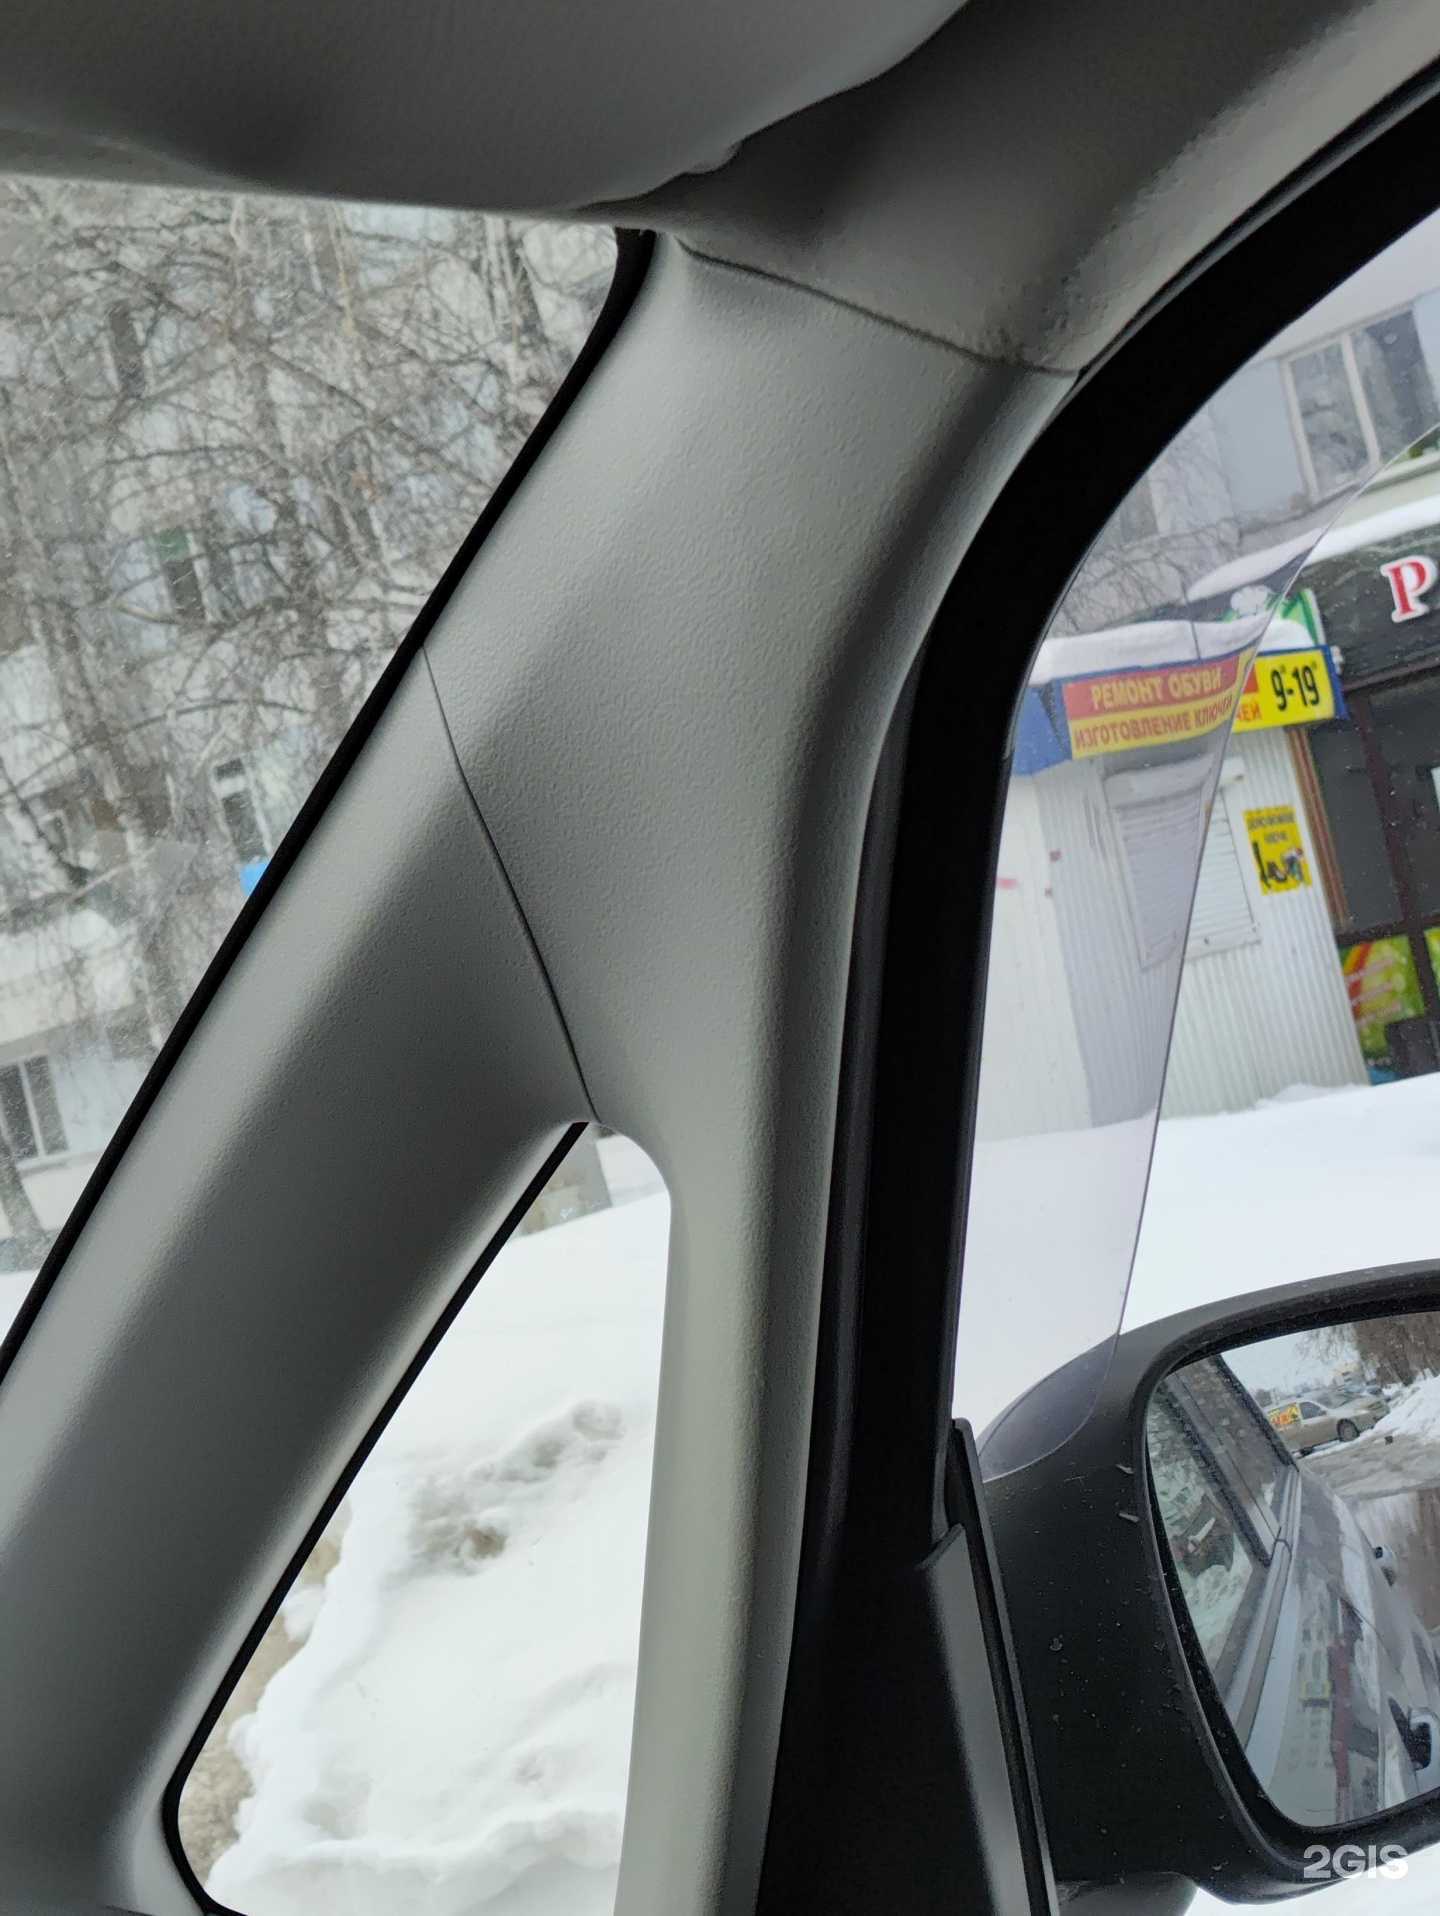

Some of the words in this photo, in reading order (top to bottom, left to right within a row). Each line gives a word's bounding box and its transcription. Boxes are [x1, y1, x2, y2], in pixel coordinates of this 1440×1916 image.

[1090, 676, 1162, 711] РЕМОНТ
[1168, 667, 1222, 699] ОБУВИ
[1073, 711, 1191, 750] ИЗГОТОВЛЕНИЕ
